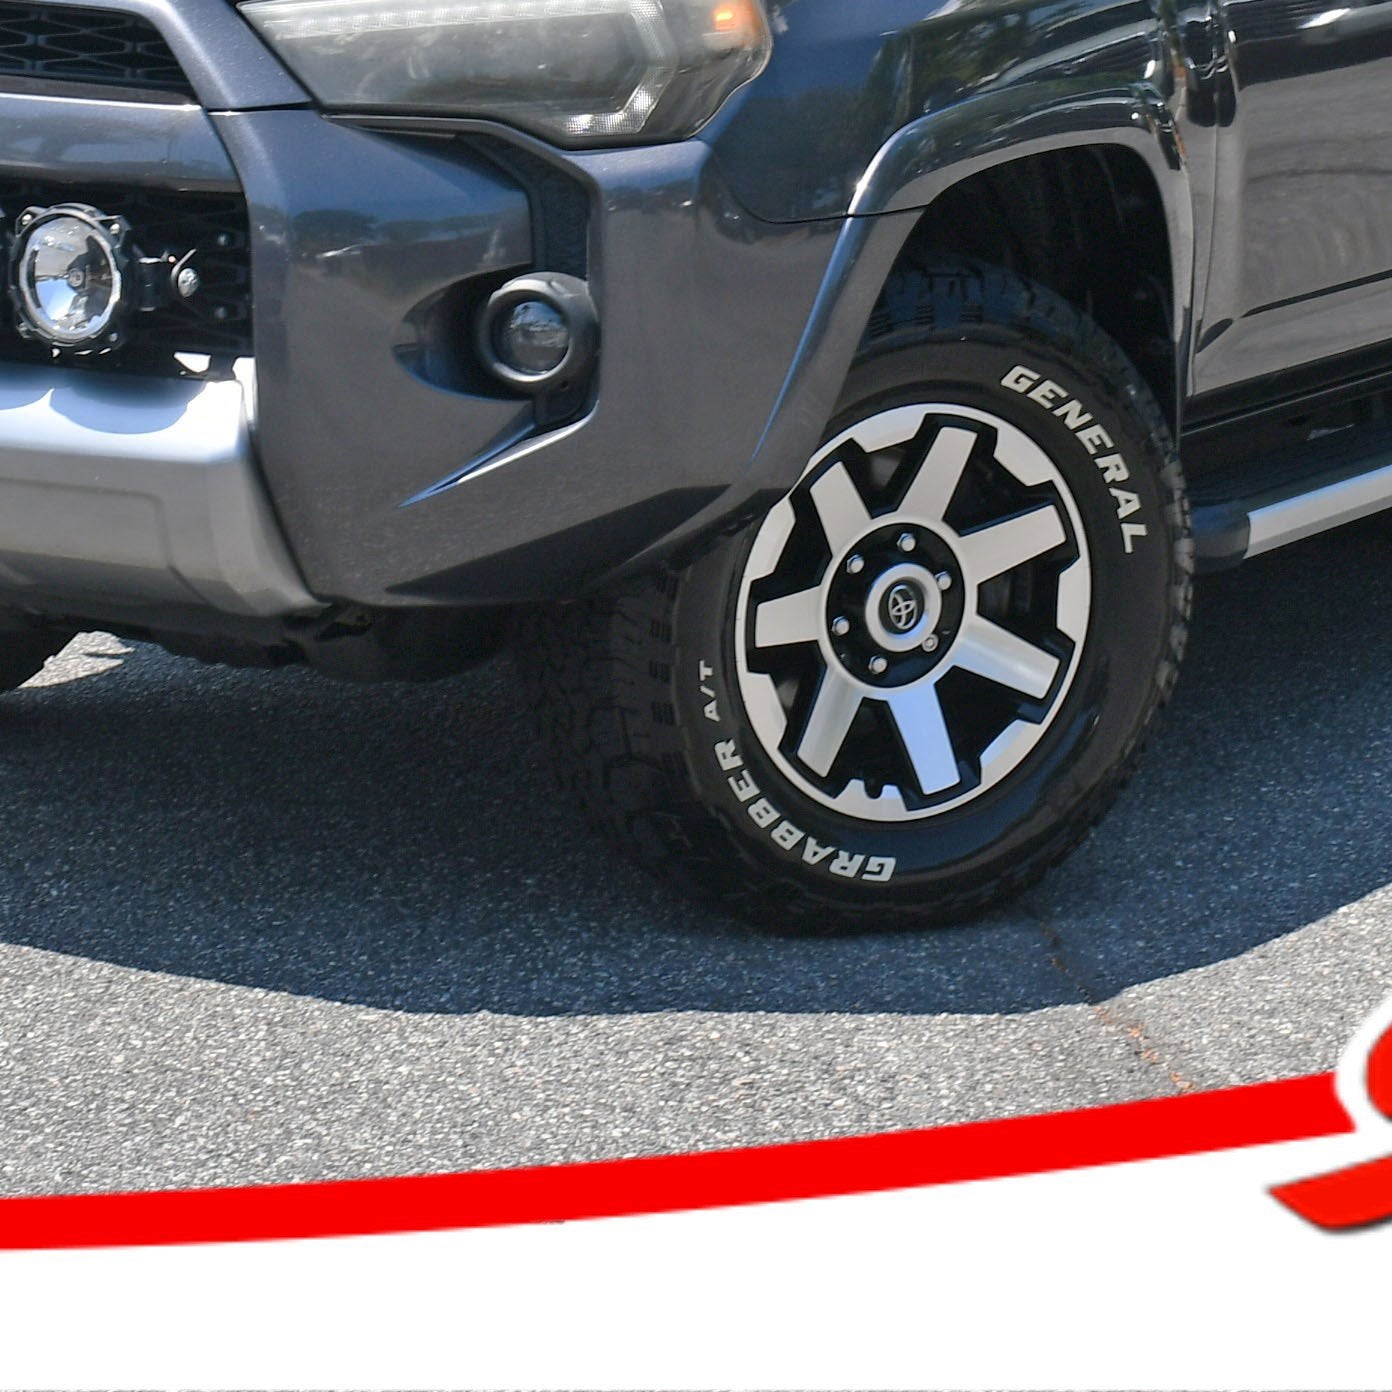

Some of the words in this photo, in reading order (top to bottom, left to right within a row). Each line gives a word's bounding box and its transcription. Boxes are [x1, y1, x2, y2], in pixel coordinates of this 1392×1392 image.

[1001, 365, 1148, 554] GENERAL
[699, 660, 721, 722] A/T
[714, 739, 896, 882] GRABBER
